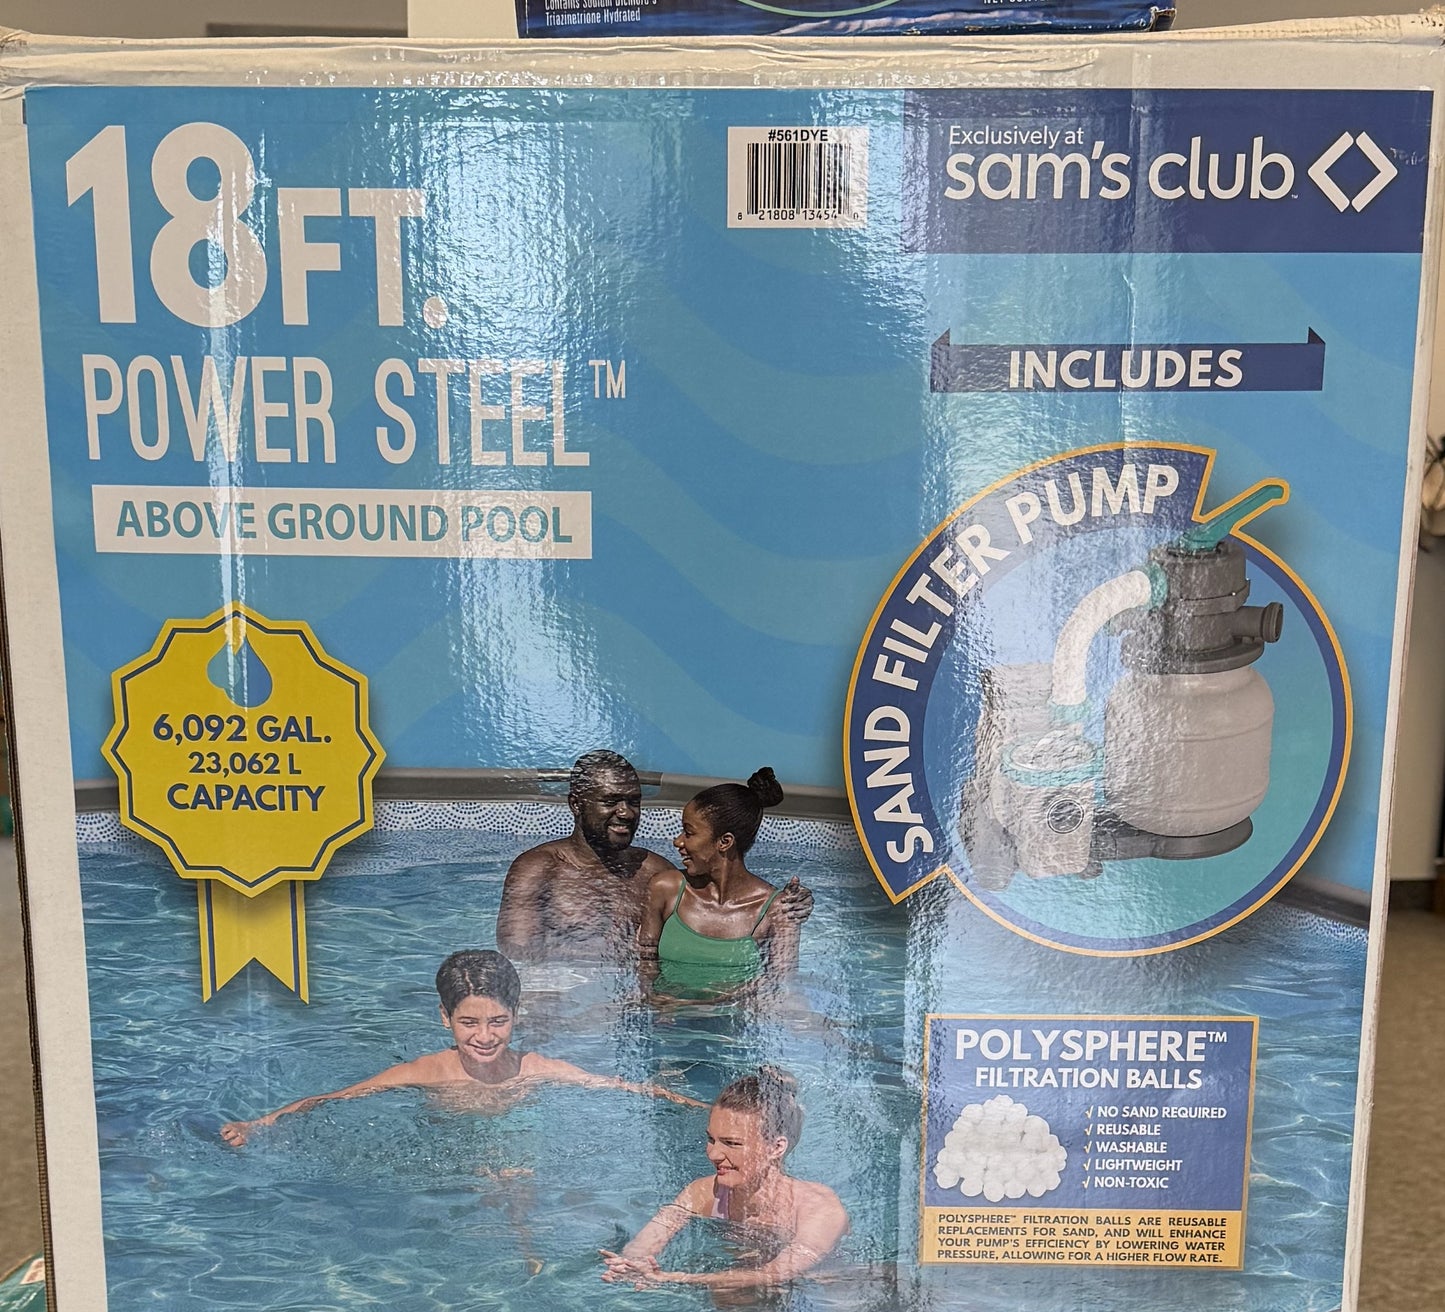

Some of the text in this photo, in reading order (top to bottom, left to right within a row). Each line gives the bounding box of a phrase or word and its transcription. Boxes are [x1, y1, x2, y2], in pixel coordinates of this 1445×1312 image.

[546, 8, 641, 26] Triazinetrione Hydrated
[768, 129, 829, 142] #561DYE
[949, 125, 1084, 149] Exclusively at
[943, 140, 1131, 200] sam's
[758, 210, 838, 221] 21808 13454
[1008, 348, 1245, 390] INCLUDES
[82, 353, 337, 465] POWER
[116, 500, 573, 545] ABOVE GROUND POOL
[863, 463, 1181, 863] SAND FILTER PUMP
[152, 713, 332, 745] 6,092 GAL.
[188, 752, 302, 777] 23,062 L
[166, 783, 326, 812] CAPACITY
[975, 1066, 1203, 1090] FILTRATION BALLS
[1097, 1105, 1227, 1119] NO SAND REQUIRED
[1096, 1123, 1162, 1136] REUSABLE
[1095, 1141, 1168, 1154] WASHABLE
[1094, 1158, 1183, 1171] LIGHTWEIGHT
[1094, 1176, 1169, 1189] NON-TOXIC
[1023, 1215, 1089, 1225] FILTRATION
[1095, 1216, 1131, 1226] BALLS
[1138, 1217, 1161, 1226] ARE
[1168, 1217, 1227, 1227] REUSABLE
[938, 1226, 1226, 1239] REPLACEMENTS FOR SAND, AND WILL ENHANCE
[937, 1238, 1226, 1251] YOUR PUMP'S EFFICIENCY BY LOWERING WATER
[937, 1249, 1223, 1263] PRESSURE, ALLOWING FOR A HIGHER FLOW RATE.
